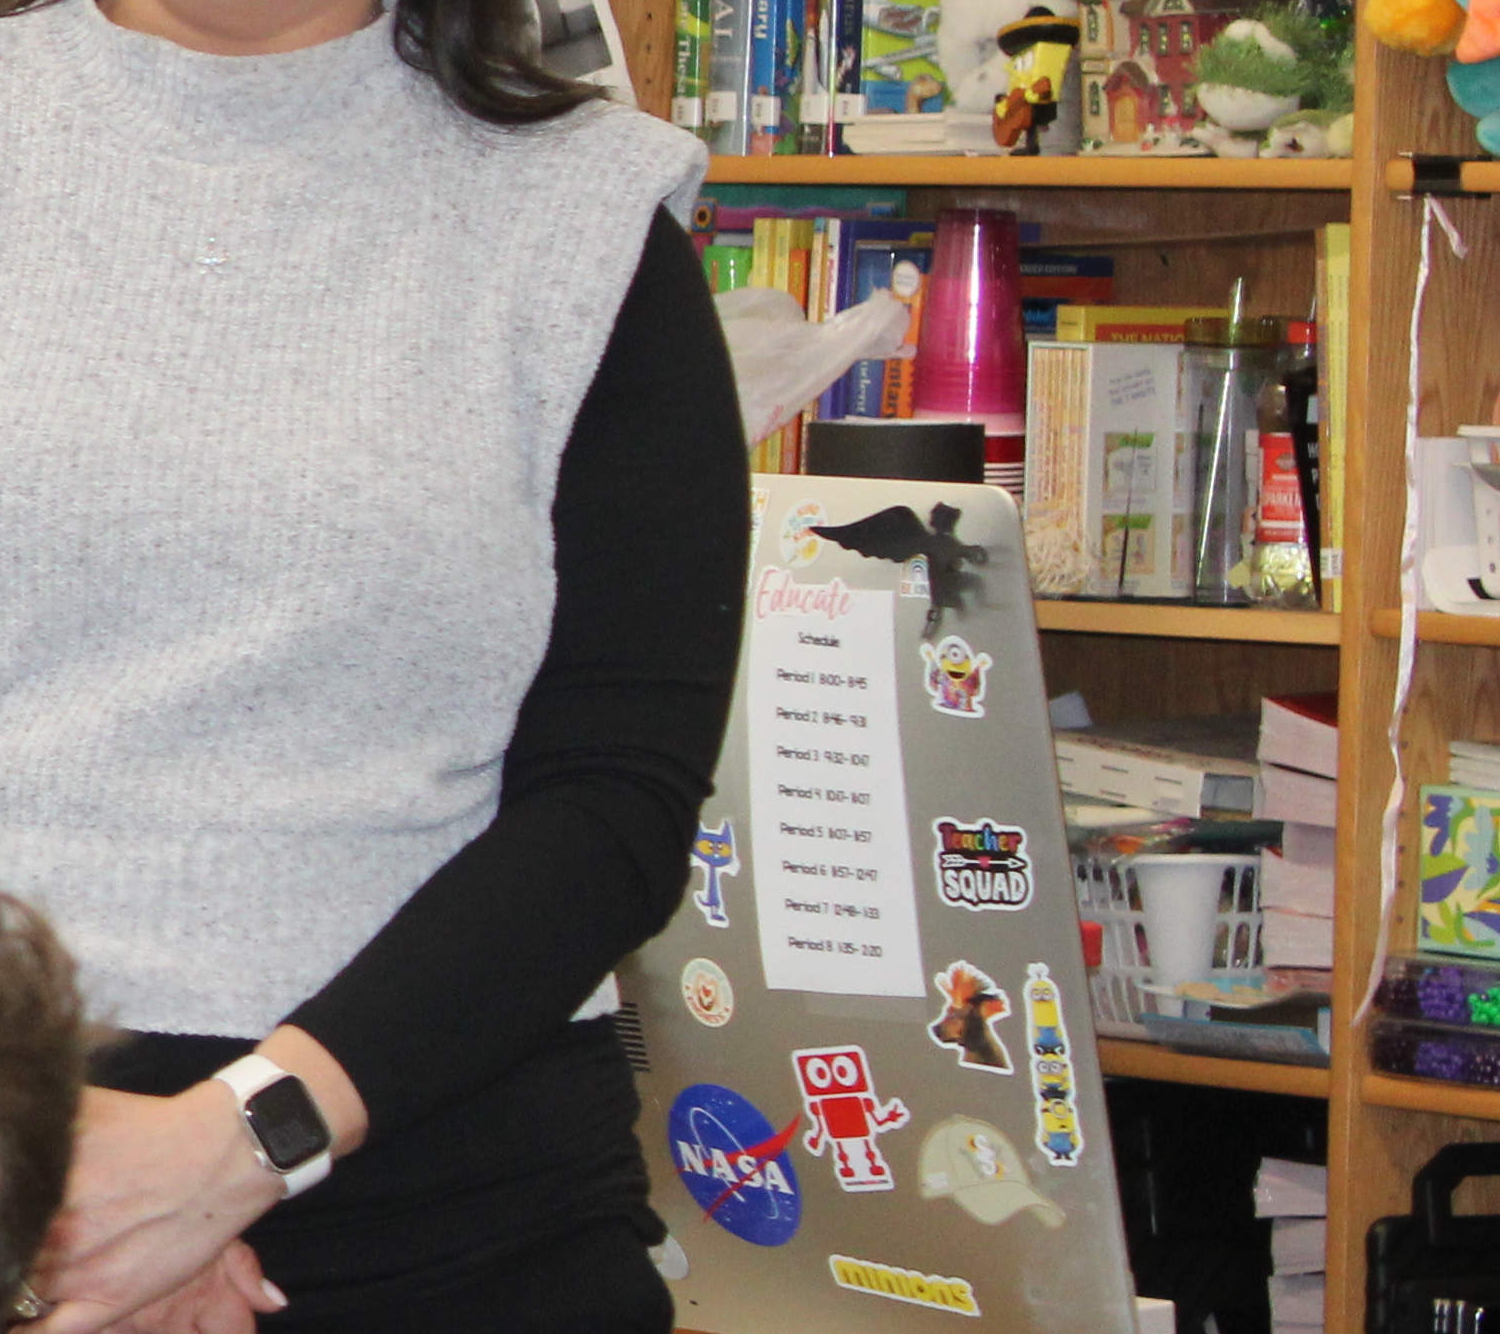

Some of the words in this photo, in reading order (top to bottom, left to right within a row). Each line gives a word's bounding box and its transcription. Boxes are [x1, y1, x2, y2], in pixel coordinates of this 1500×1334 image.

[756, 569, 854, 620] Educate
[799, 631, 841, 648] Schedule
[776, 668, 810, 683] Period
[776, 706, 810, 722] Period
[777, 745, 811, 761] Period
[778, 784, 812, 799] Period
[780, 822, 814, 837] Period
[938, 823, 1022, 852] Teacher
[783, 860, 817, 875] Period
[944, 870, 1026, 902] SQUAD
[785, 898, 820, 913] Period
[788, 936, 824, 951] Period
[677, 1140, 794, 1195] NASA
